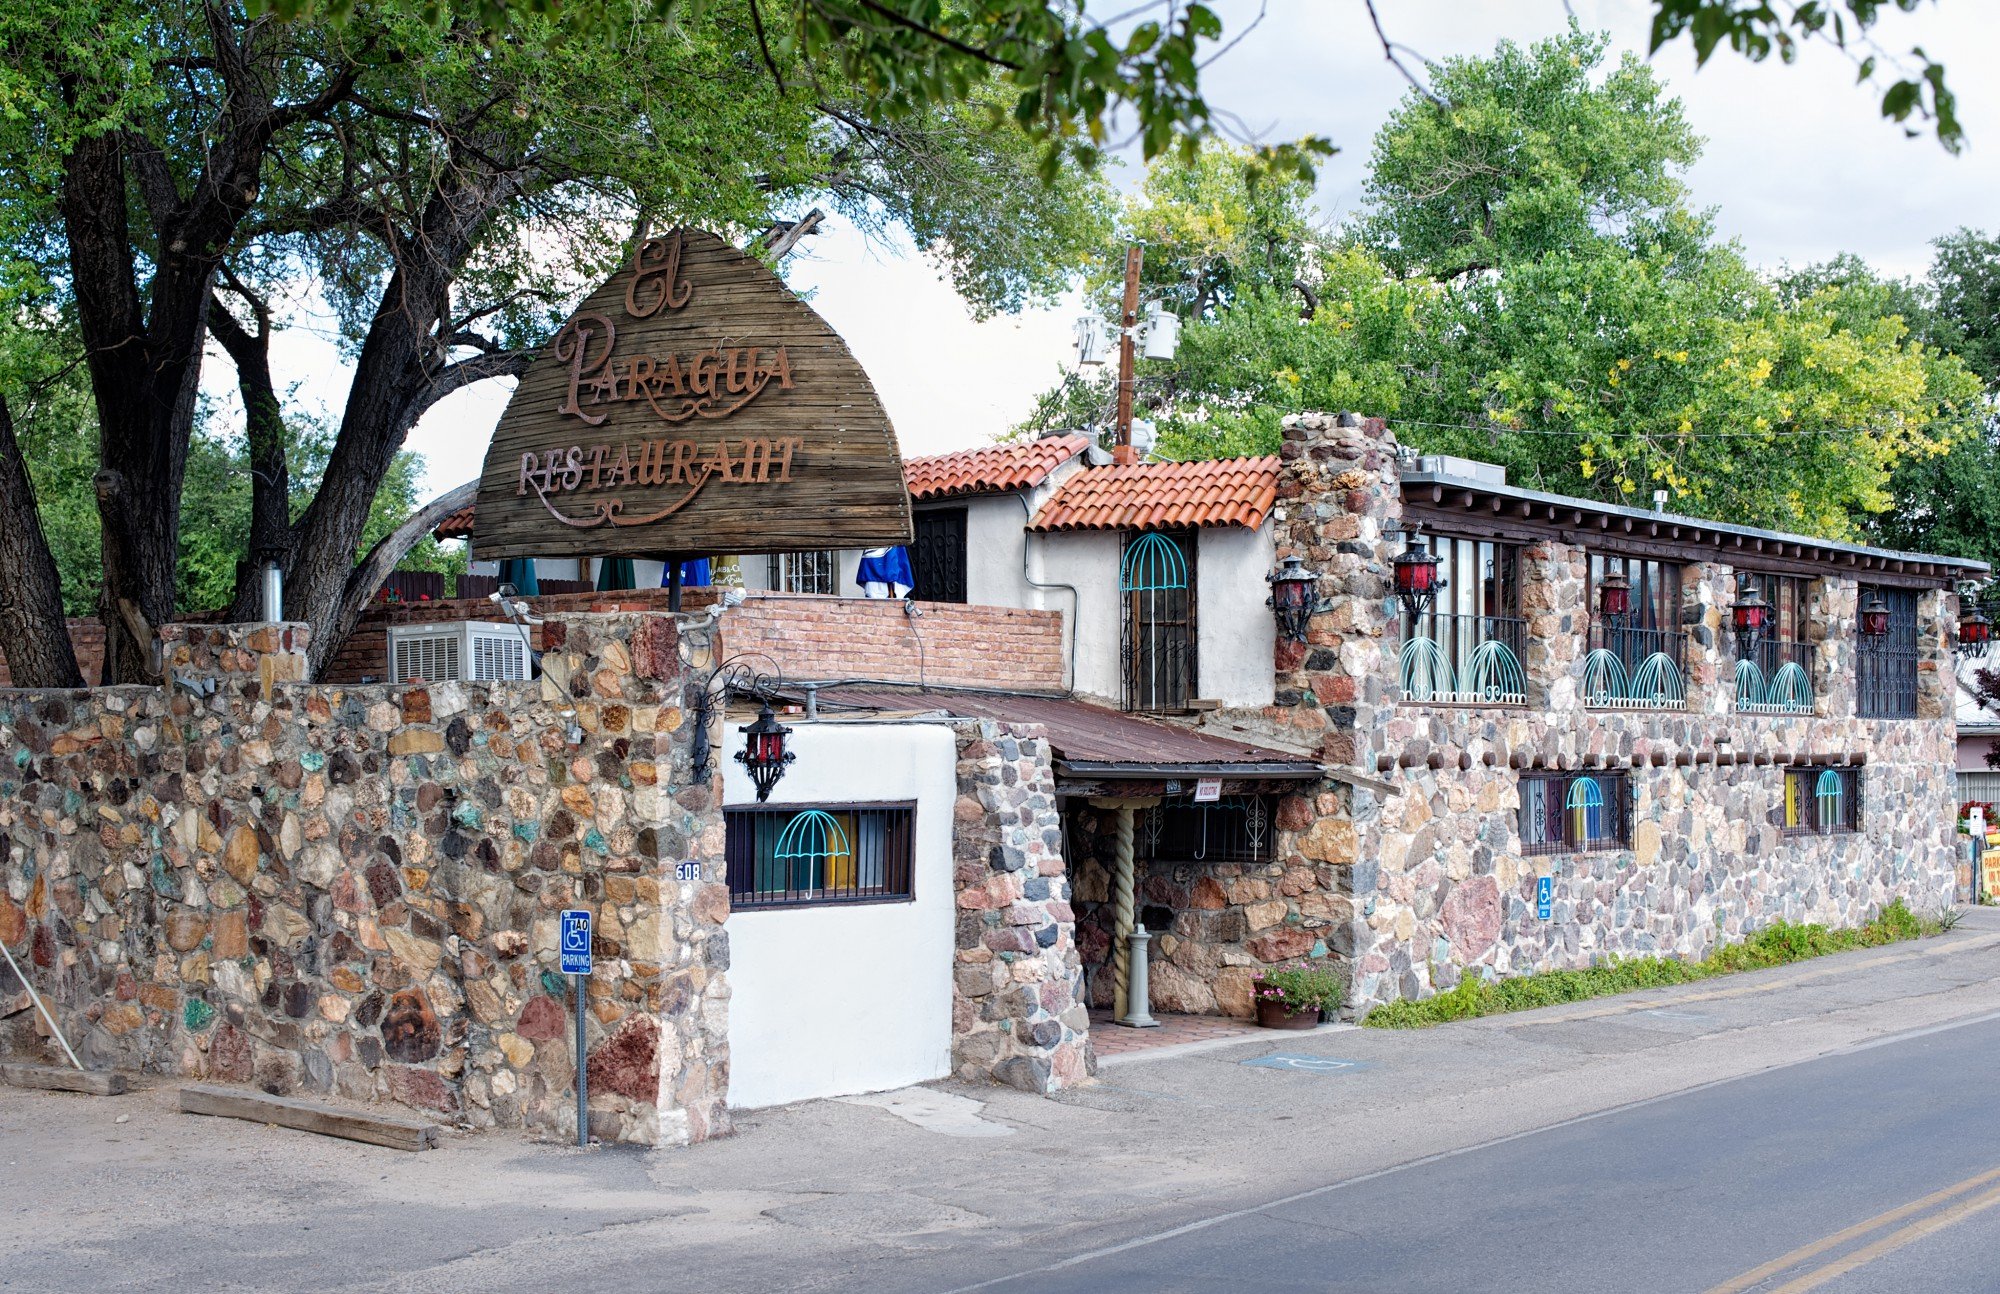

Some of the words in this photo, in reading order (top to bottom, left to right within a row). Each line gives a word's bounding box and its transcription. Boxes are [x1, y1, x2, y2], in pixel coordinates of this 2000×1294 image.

[625, 230, 693, 318] El
[554, 312, 798, 425] PARAGUA
[516, 436, 804, 527] RESTAURANT
[676, 864, 700, 880] 608
[562, 953, 590, 966] PARKING
